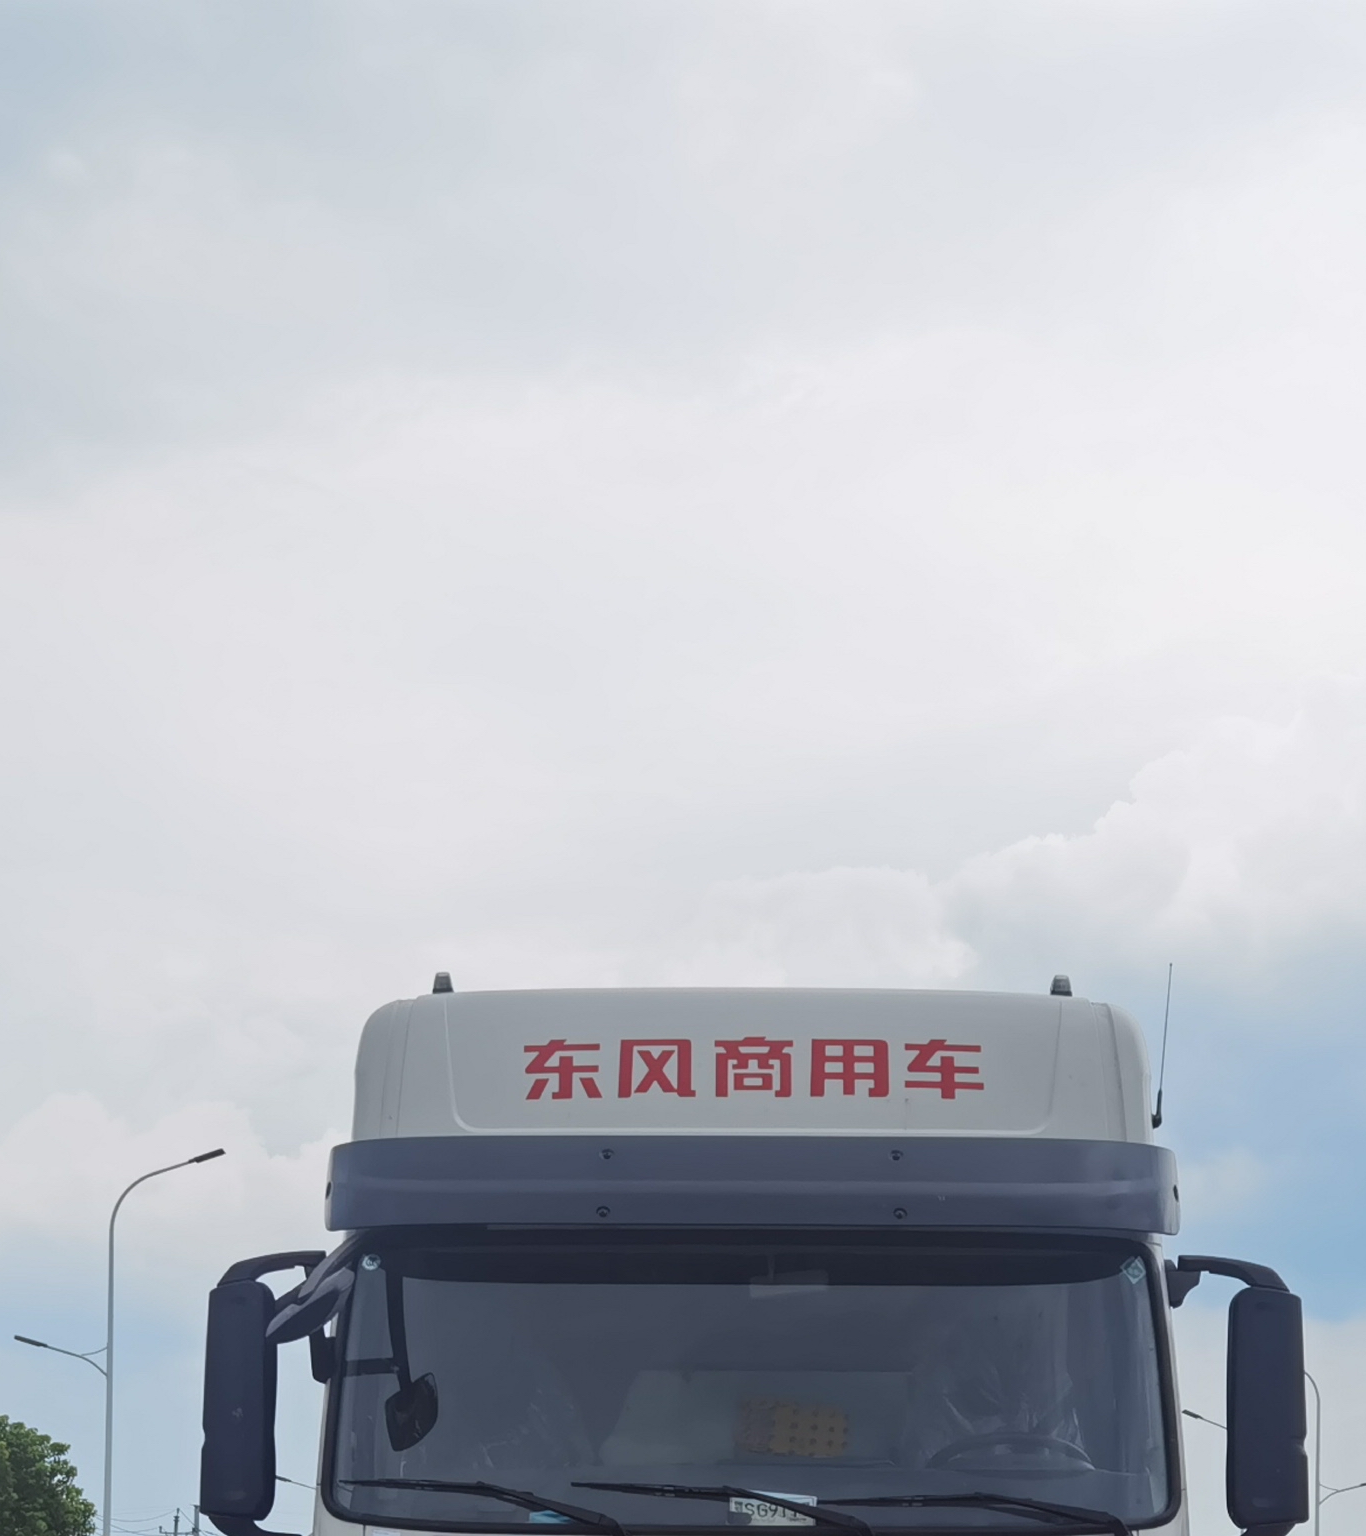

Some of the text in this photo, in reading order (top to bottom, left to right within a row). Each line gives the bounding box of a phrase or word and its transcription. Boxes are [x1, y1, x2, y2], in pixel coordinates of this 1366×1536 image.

[523, 1036, 985, 1100] 东风商用车
